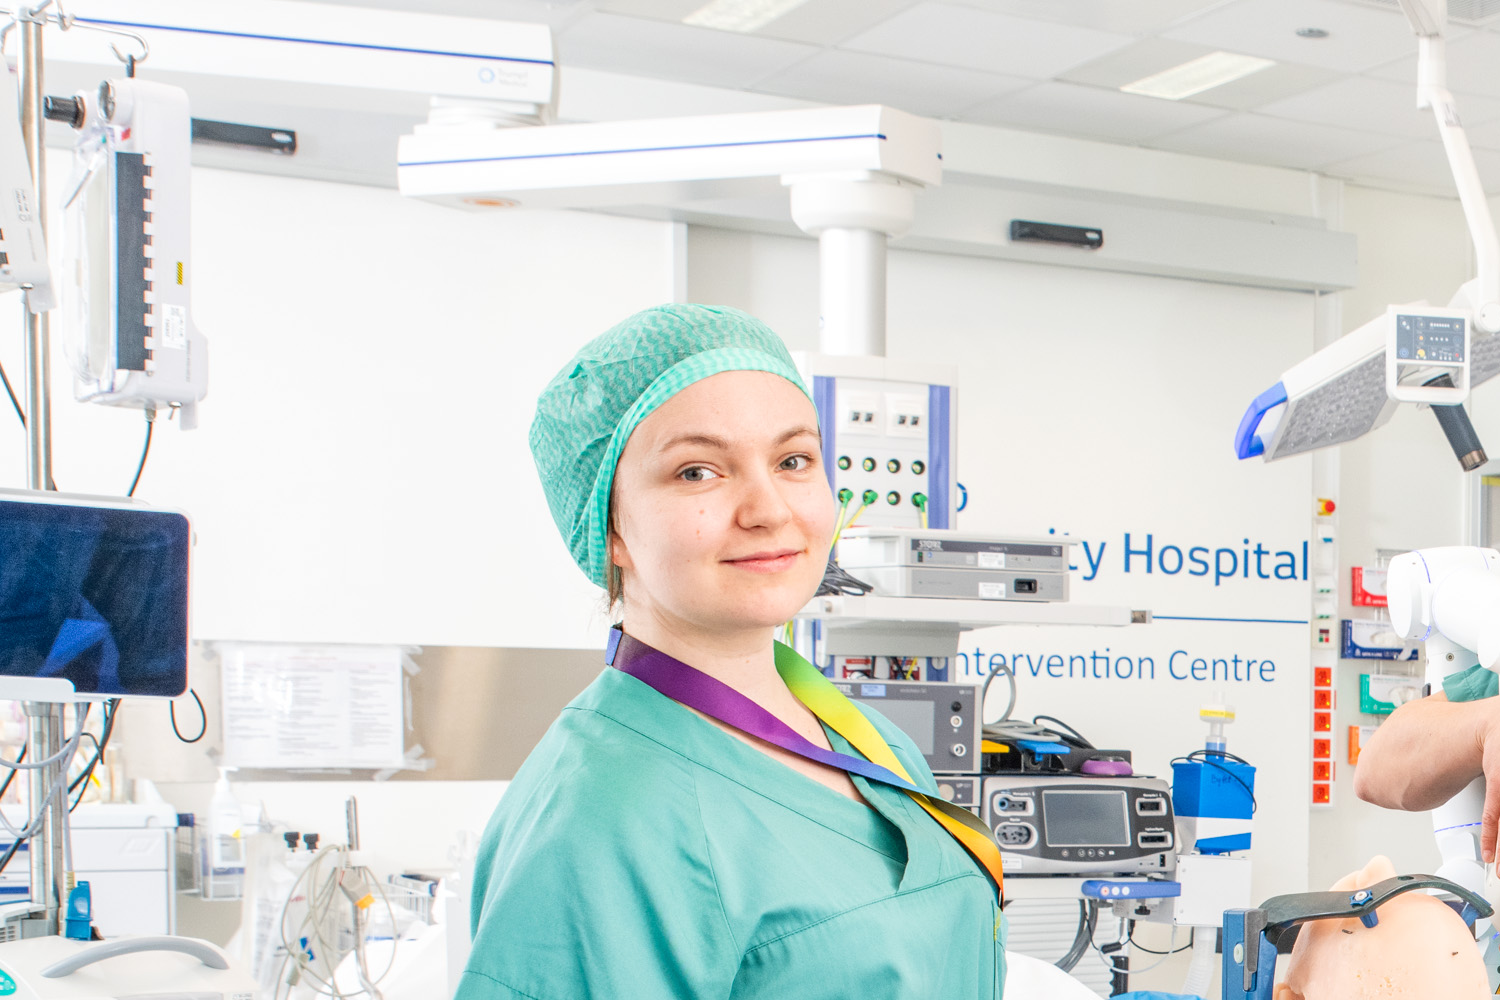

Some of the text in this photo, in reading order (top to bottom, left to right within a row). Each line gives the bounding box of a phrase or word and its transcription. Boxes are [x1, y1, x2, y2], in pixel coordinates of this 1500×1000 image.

[1124, 532, 1309, 586] Hospital
[957, 647, 1276, 682] ntervention Centre
